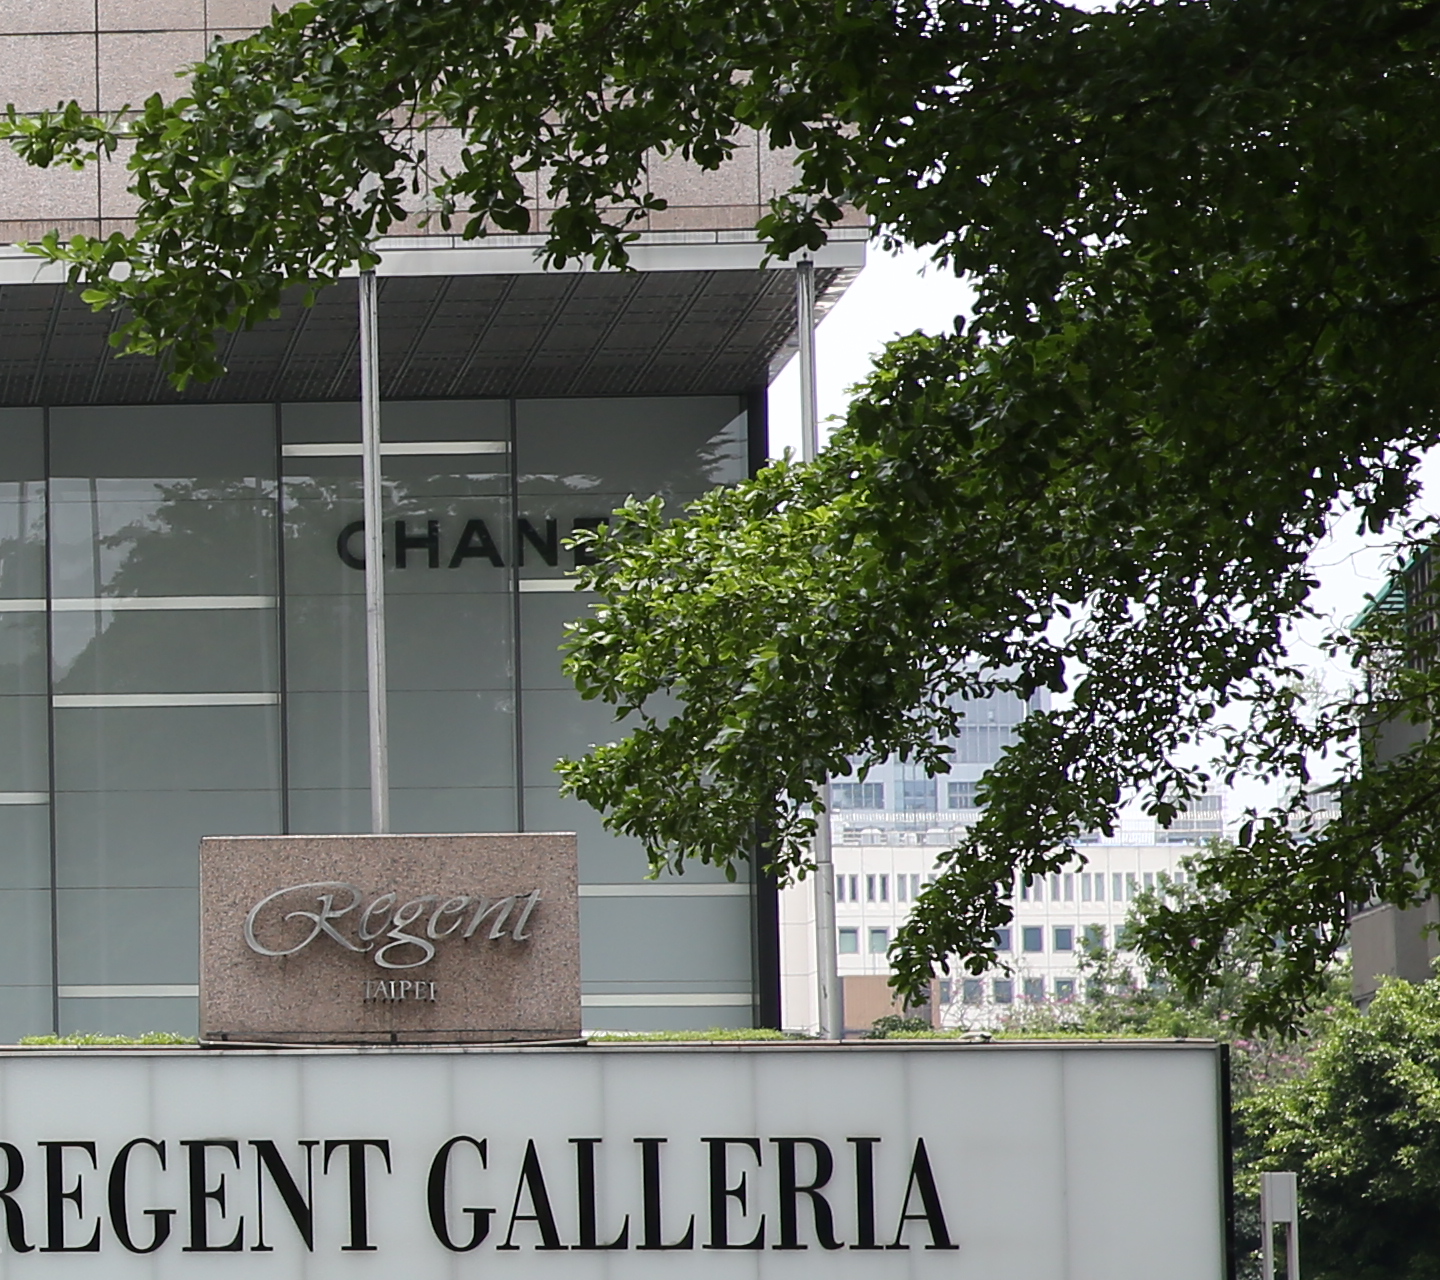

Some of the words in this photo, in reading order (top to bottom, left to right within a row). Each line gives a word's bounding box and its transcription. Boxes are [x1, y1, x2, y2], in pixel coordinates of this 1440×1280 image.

[336, 517, 611, 571] CHANE
[243, 880, 543, 969] Regent
[362, 980, 436, 1001] TAIPEI
[426, 1135, 960, 1253] GALLERIA
